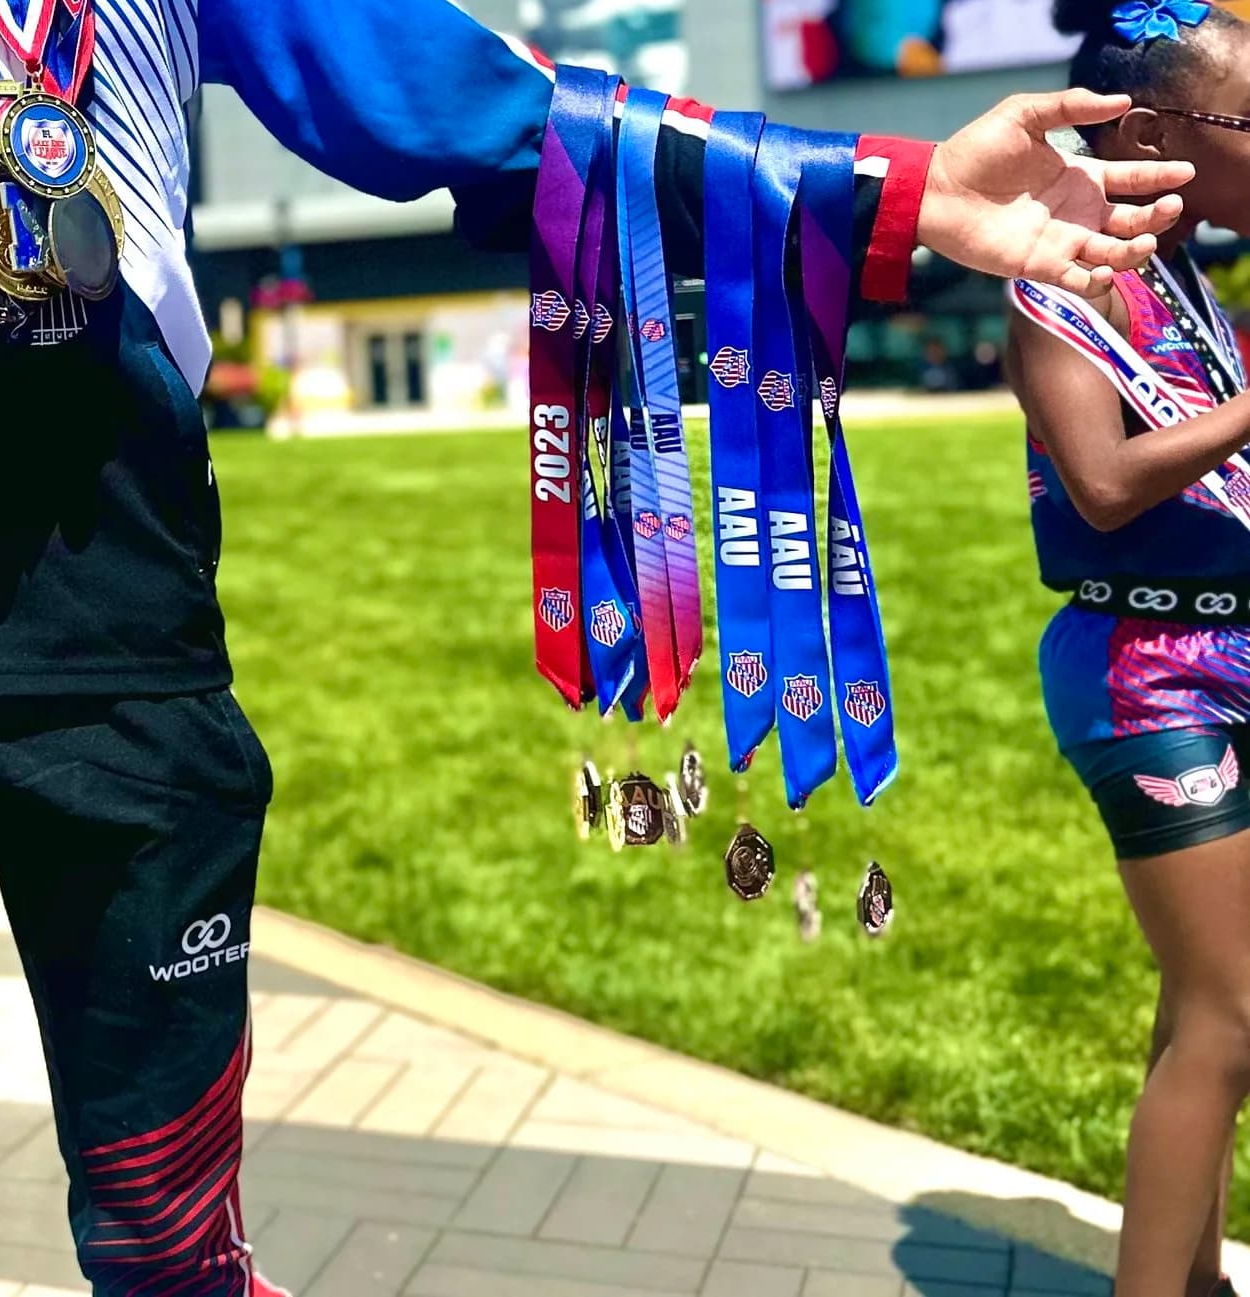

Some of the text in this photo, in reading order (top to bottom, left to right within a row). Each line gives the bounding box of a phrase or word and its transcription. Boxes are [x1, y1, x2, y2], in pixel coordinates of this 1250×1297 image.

[1025, 286, 1042, 303] FOR
[1069, 314, 1111, 353] FOREVER
[534, 403, 571, 504] 2023
[652, 413, 683, 454] AAU
[717, 486, 760, 567] AAU
[769, 510, 813, 590] AAU
[830, 515, 865, 595] AAU
